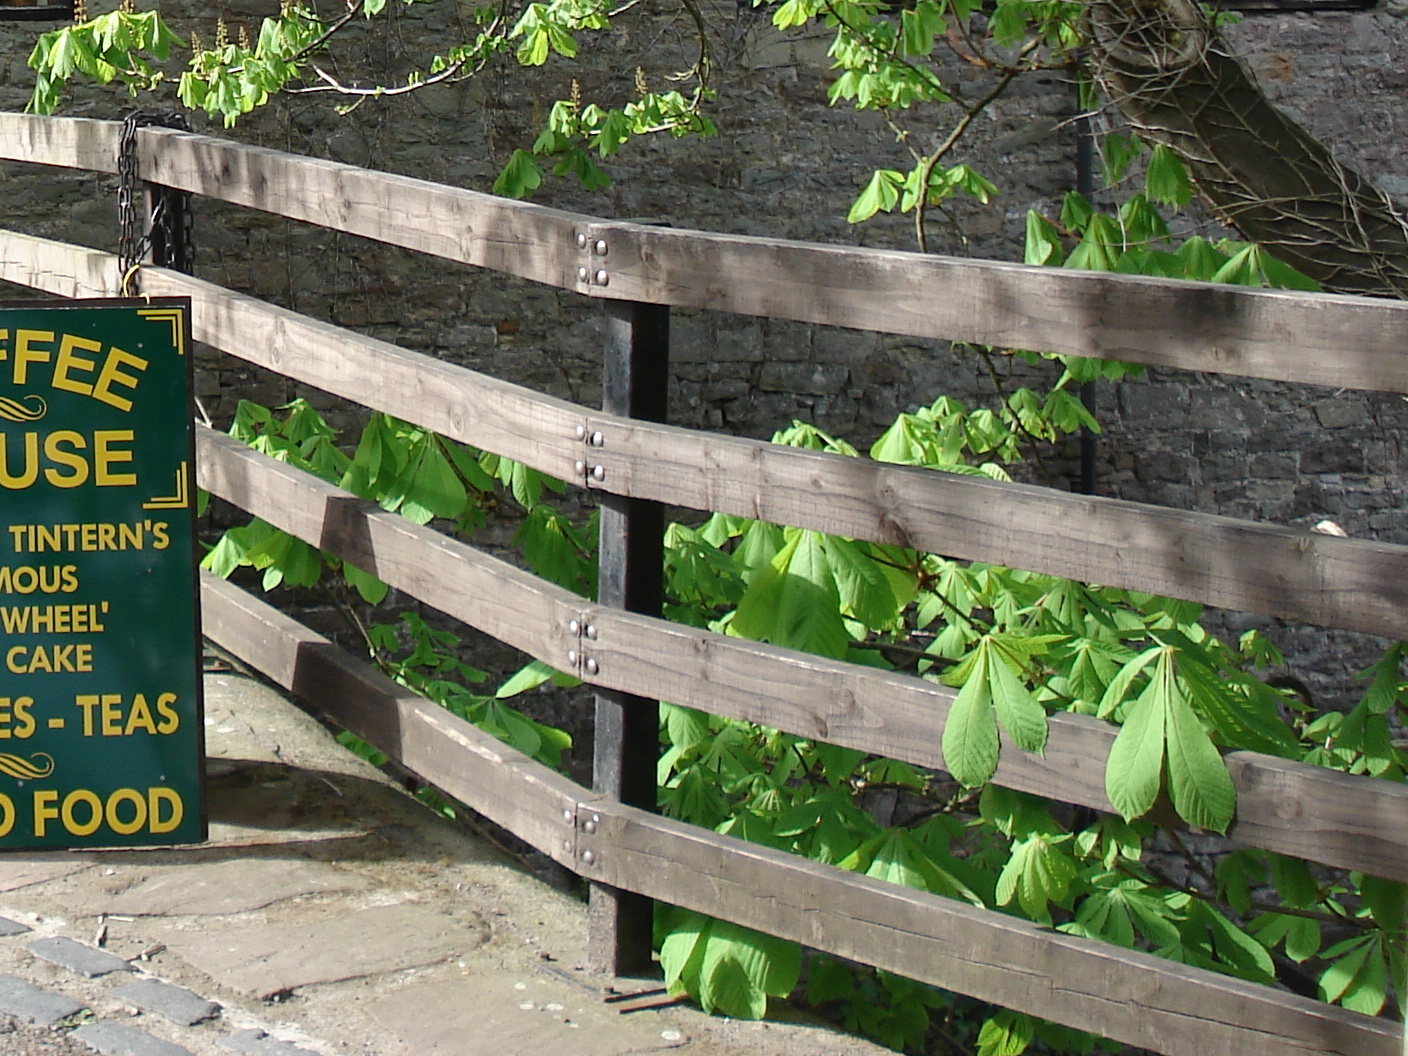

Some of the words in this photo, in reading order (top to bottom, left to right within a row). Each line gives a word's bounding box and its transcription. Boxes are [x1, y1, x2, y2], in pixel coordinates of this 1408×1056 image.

[9, 520, 170, 553] TINTERN'S
[0, 601, 110, 634] WHEEL'
[6, 644, 93, 673] CAKE
[76, 692, 180, 737] TEAS
[33, 786, 185, 838] FOOD
